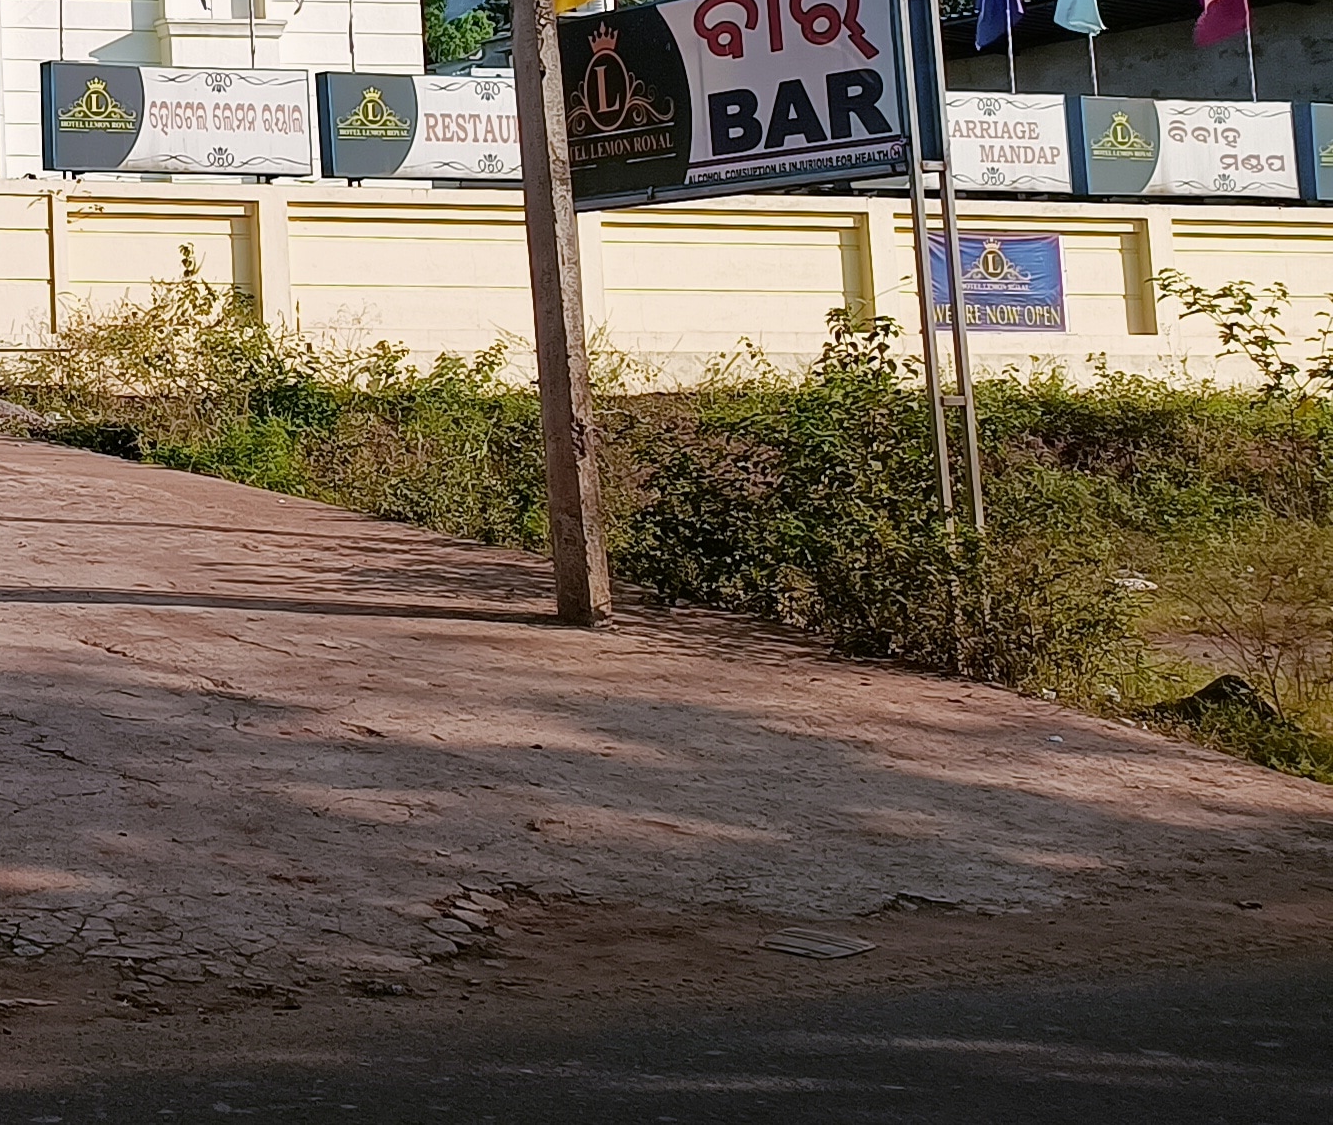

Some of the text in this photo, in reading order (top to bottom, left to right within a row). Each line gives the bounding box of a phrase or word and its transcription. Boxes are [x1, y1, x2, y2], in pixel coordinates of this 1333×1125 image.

[593, 64, 620, 113] L
[90, 93, 106, 112] L
[366, 102, 381, 121] L
[708, 68, 893, 156] BAR
[60, 120, 84, 128] HOTEL
[947, 119, 1040, 140] ARRIAGE
[1115, 125, 1129, 142] L
[570, 132, 674, 162] TEL LEMON ROYAL
[979, 145, 1061, 165] MANDAP
[689, 172, 725, 185] ALCOHOL
[778, 162, 787, 173] IS
[788, 156, 833, 172] INJURIOUS
[835, 154, 853, 166] FOR
[855, 149, 889, 164] HEALTH
[986, 253, 1002, 274] L
[933, 303, 1061, 326] WE RE NOW OPEN
